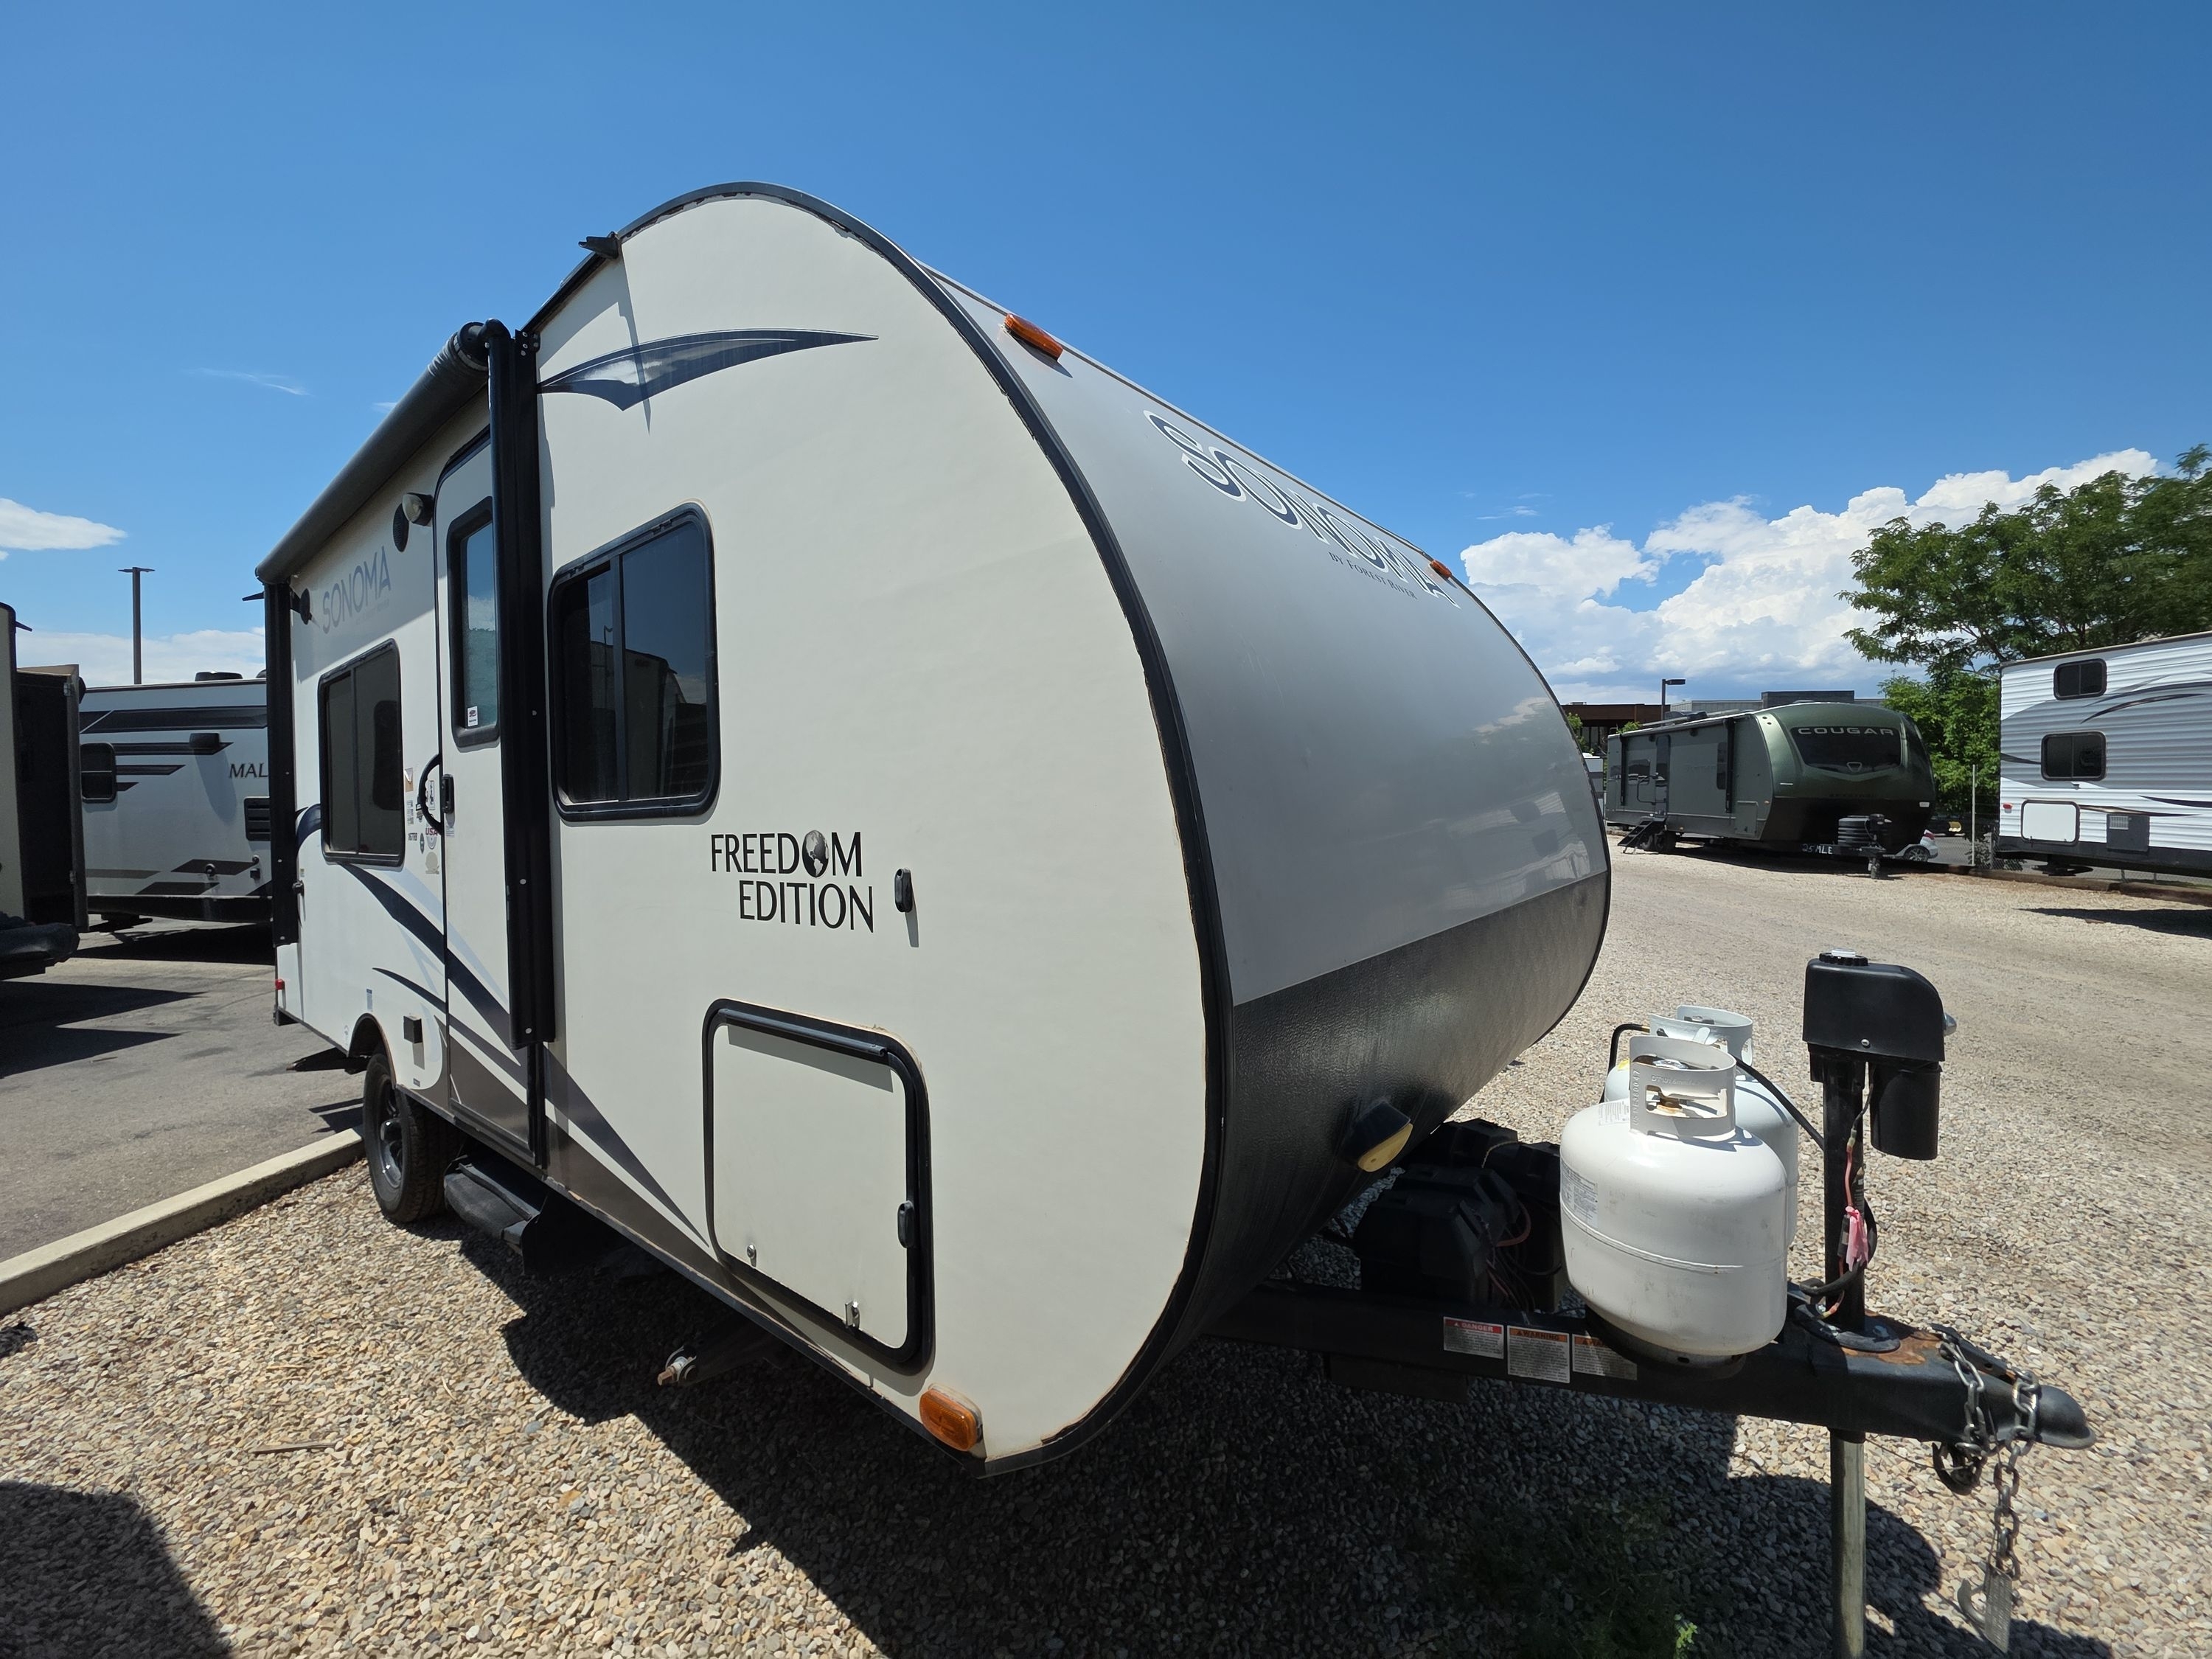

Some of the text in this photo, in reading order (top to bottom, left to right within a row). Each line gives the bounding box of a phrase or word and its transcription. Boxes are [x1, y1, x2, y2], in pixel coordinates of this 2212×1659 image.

[1143, 410, 1461, 608] SONOMA
[322, 546, 392, 634] SONOMA
[1329, 552, 1417, 599] BY FOREST RIVER
[1798, 726, 1894, 736] COUGAR
[711, 830, 862, 878] FREEDOM
[739, 880, 874, 933] EDITION
[1461, 1322, 1494, 1332] DANGER
